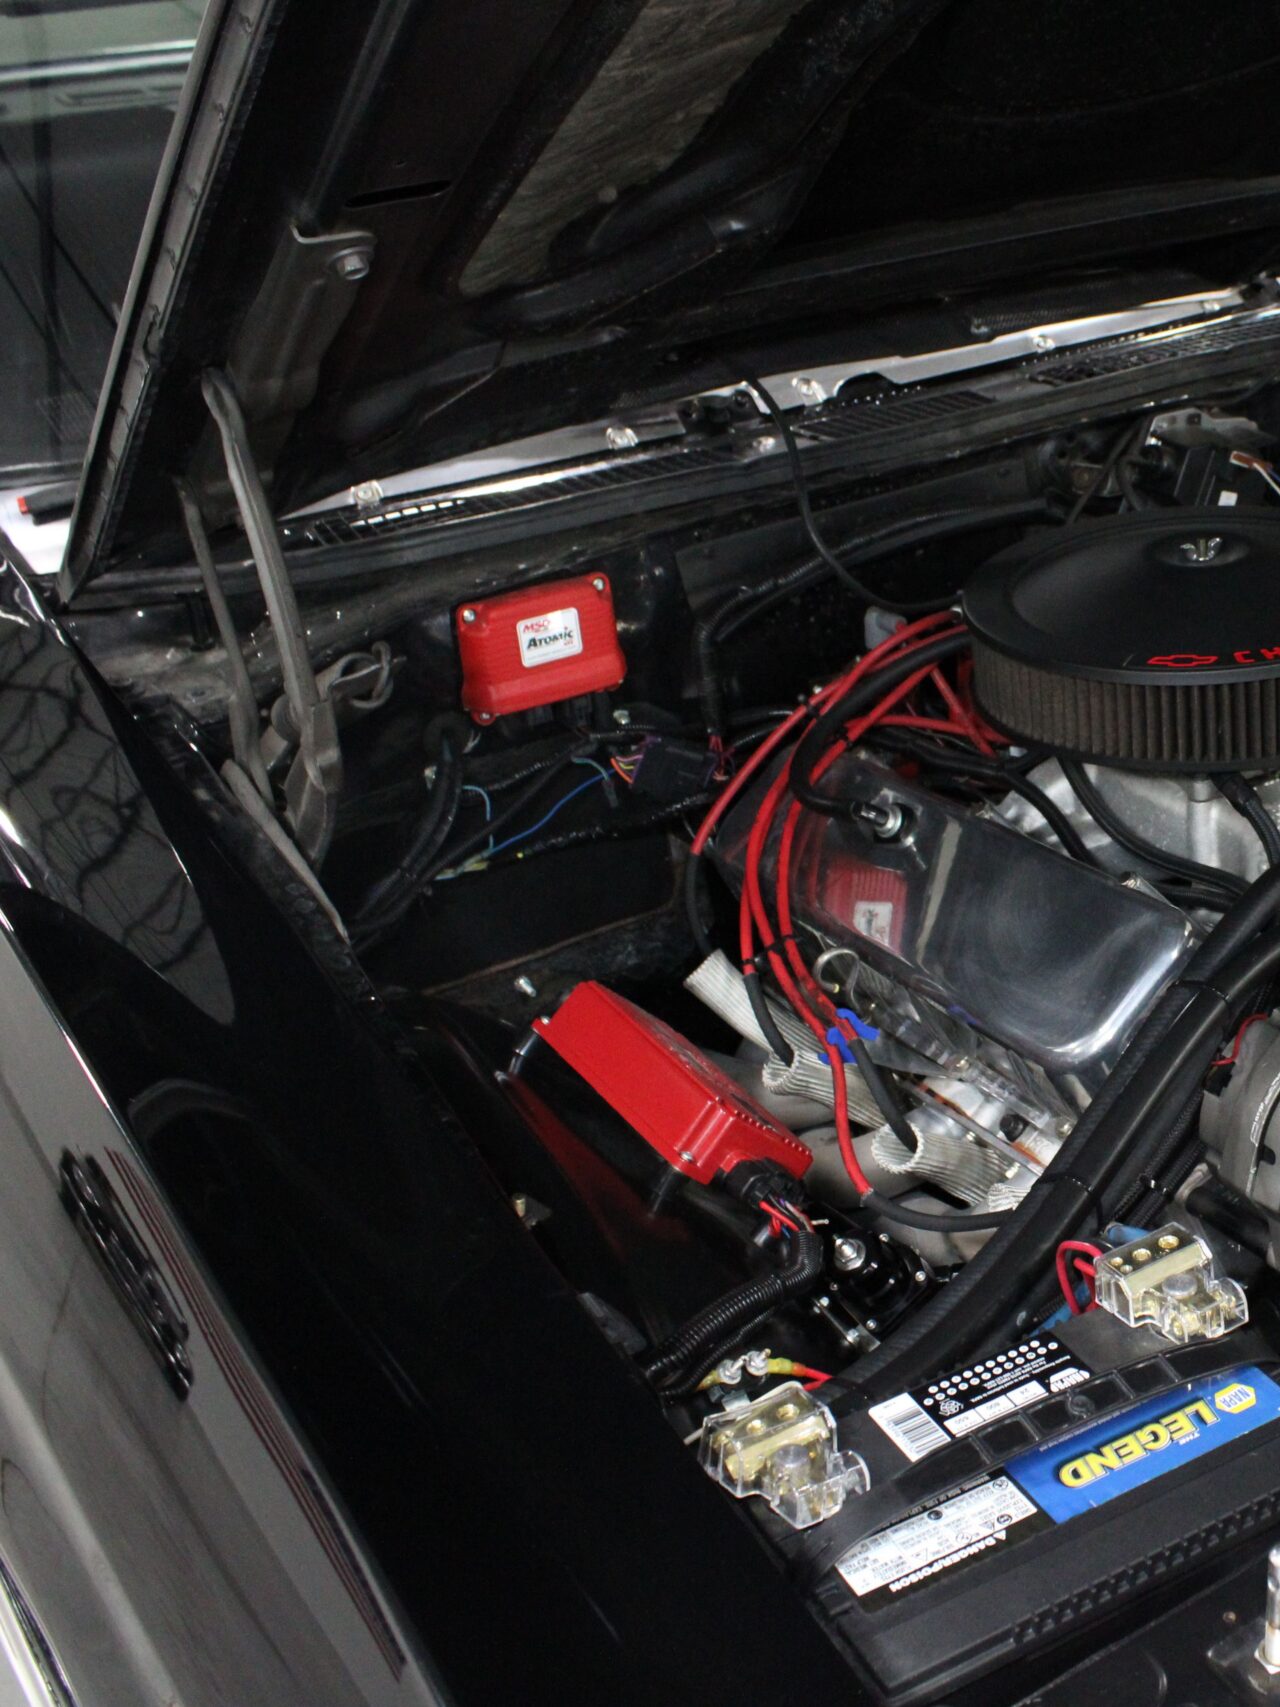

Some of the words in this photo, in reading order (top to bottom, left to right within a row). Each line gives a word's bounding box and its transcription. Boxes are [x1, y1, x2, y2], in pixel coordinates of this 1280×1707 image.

[1220, 1388, 1251, 1408] NAPA
[1059, 1399, 1220, 1489] LEGEND
[1178, 1431, 1201, 1445] THE
[887, 1536, 995, 1592] DANGER/POISON
